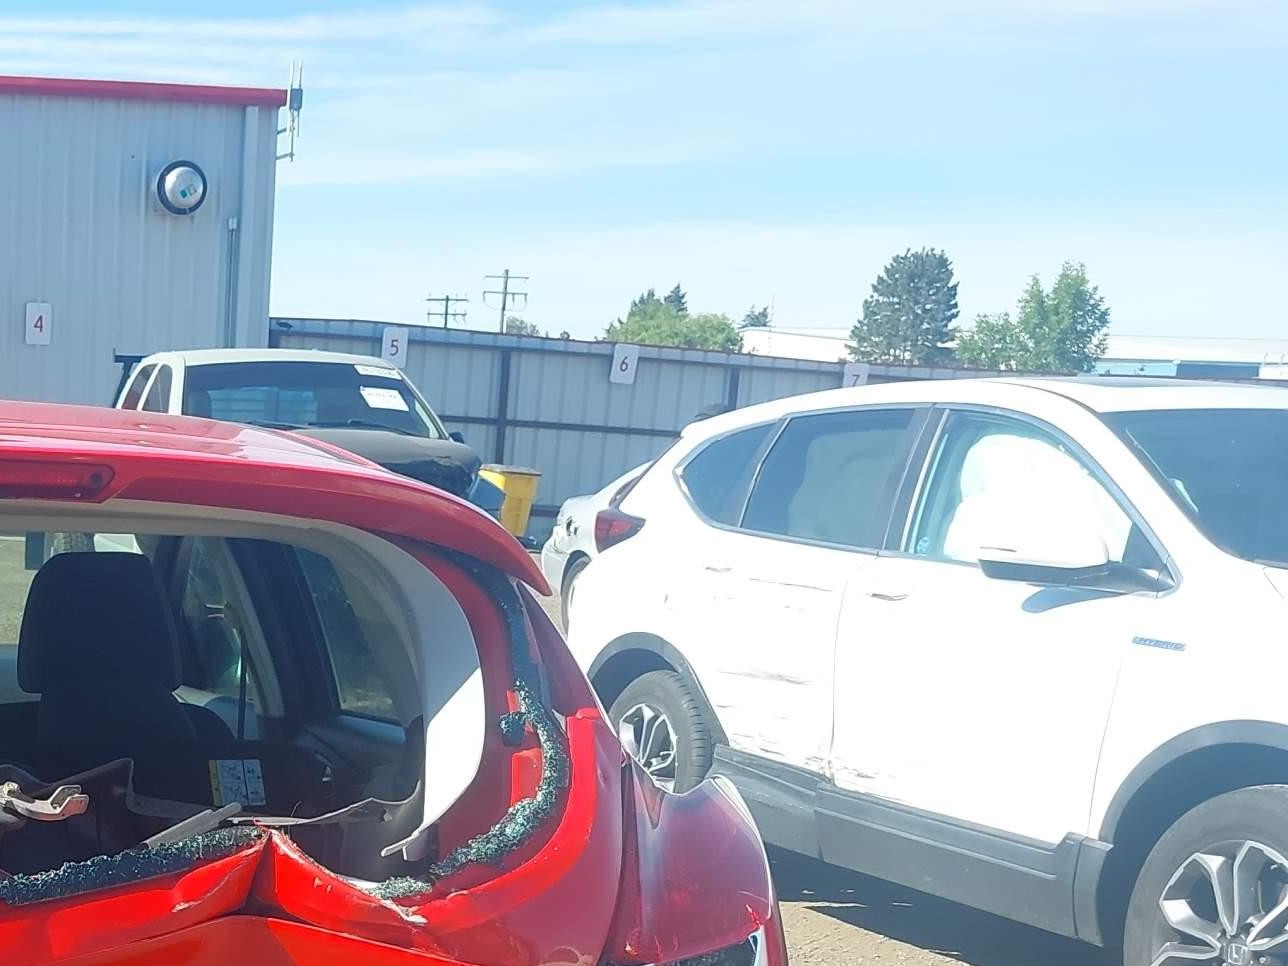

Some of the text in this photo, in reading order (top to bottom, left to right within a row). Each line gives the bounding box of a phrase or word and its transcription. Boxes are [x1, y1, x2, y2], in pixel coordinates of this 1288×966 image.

[33, 315, 43, 332] 4
[390, 339, 399, 356] 5
[619, 356, 629, 372] 6
[852, 374, 861, 387] 7
